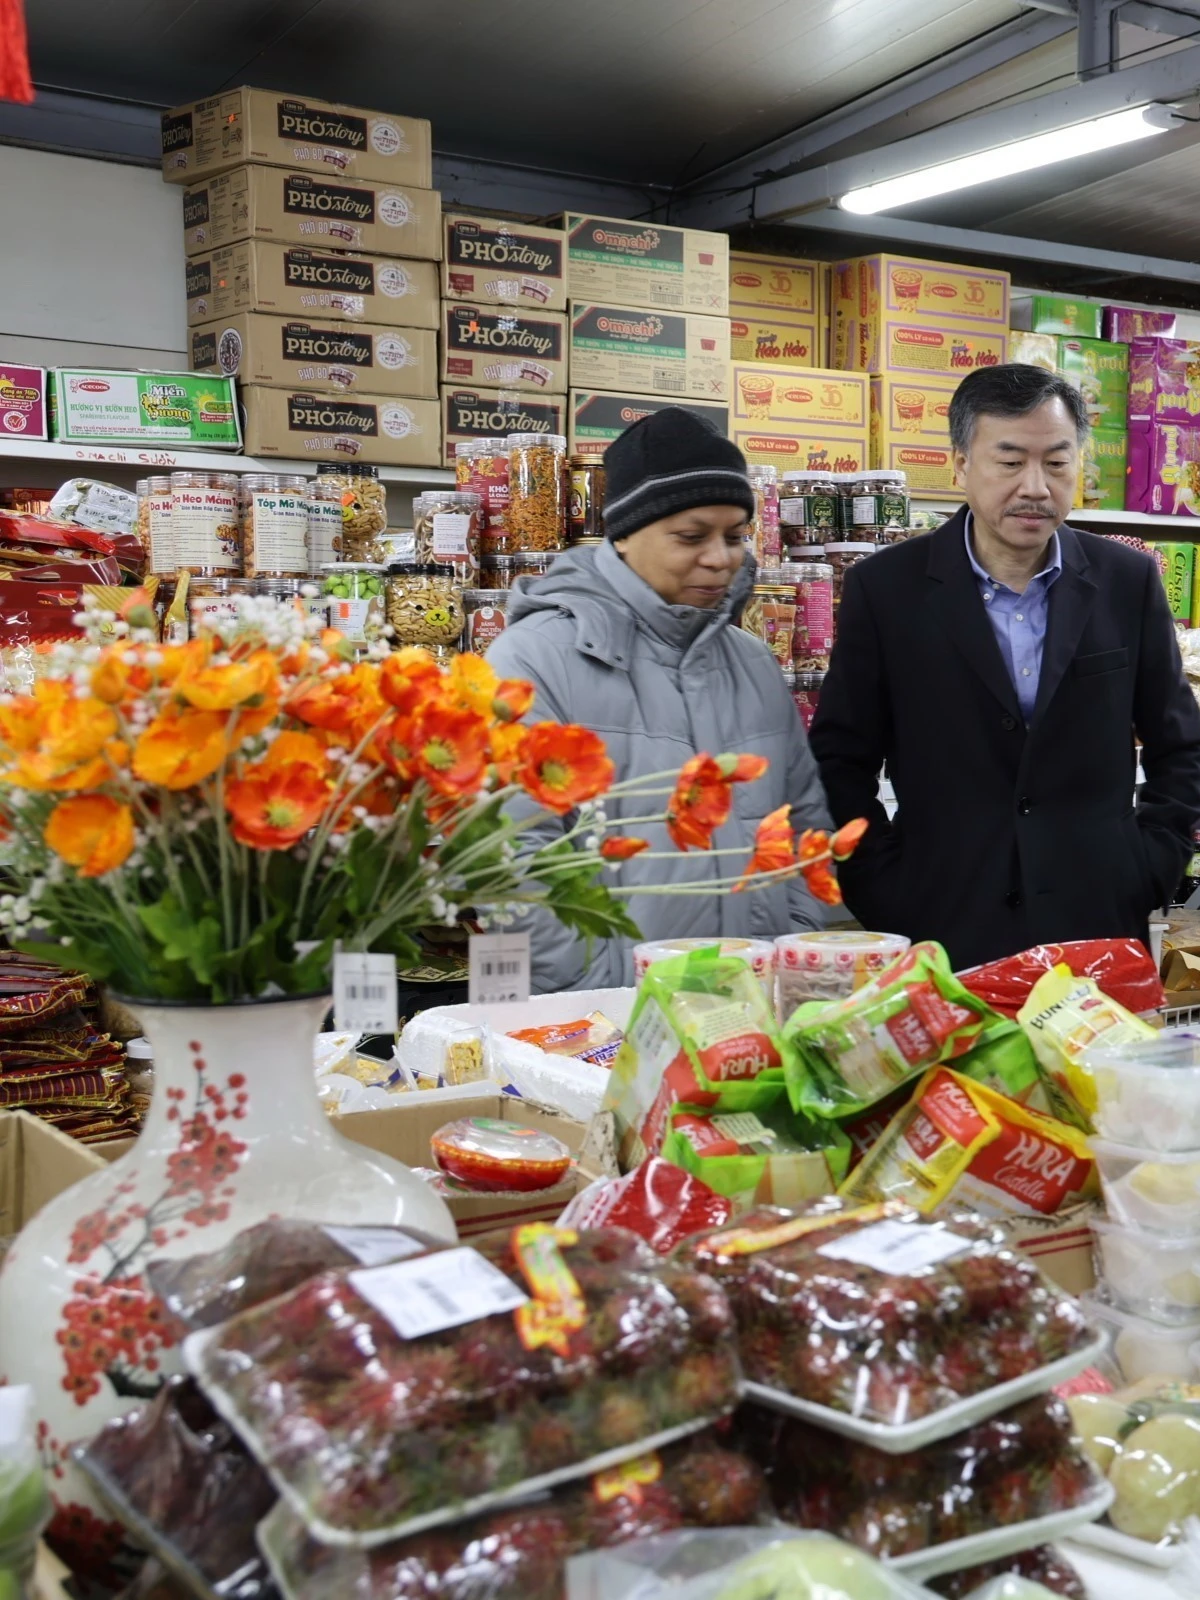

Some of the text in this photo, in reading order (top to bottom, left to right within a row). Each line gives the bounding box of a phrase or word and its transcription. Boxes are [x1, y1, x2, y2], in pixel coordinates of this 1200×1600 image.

[593, 228, 651, 249] Omachi
[597, 316, 654, 336] Omachi
[182, 494, 202, 503] Heo
[257, 498, 276, 509] Tóp
[1172, 552, 1186, 614] Custas
[719, 1054, 769, 1080] HURA
[1004, 1132, 1077, 1187] HURA
